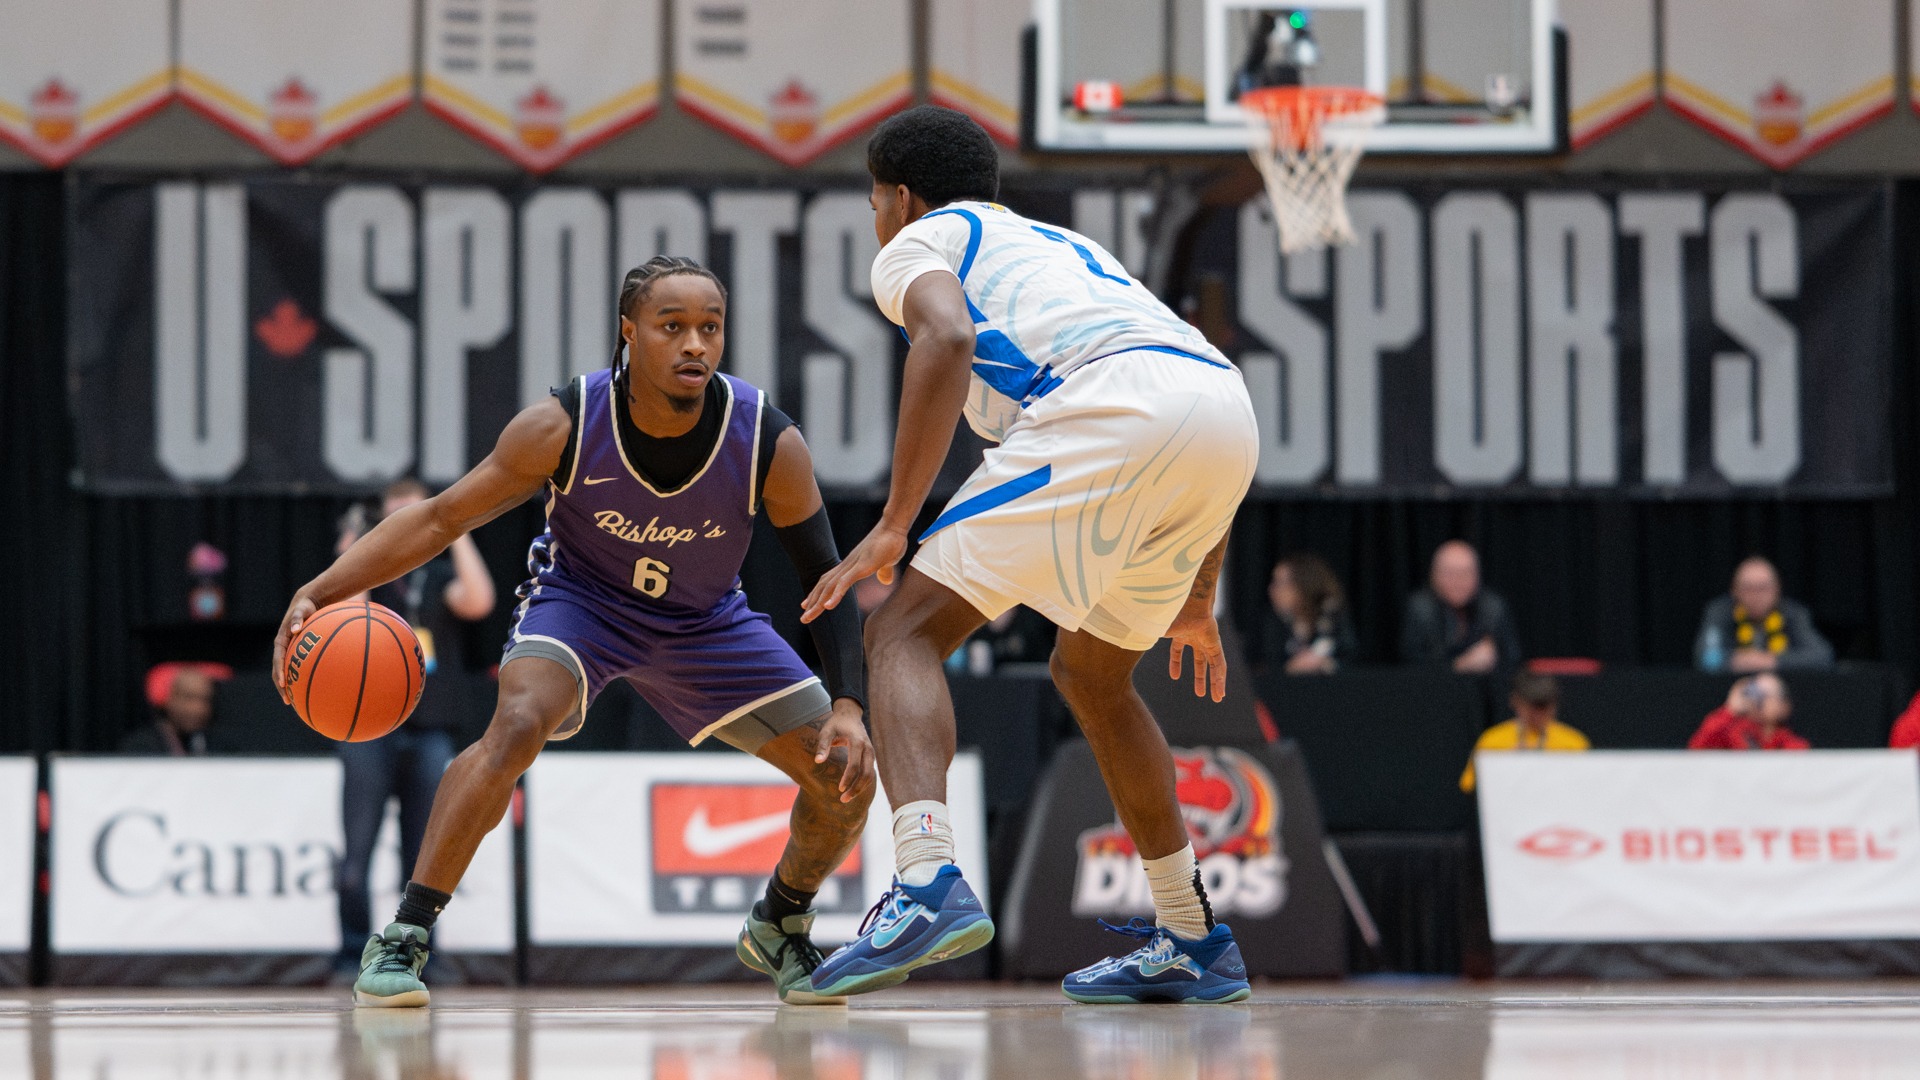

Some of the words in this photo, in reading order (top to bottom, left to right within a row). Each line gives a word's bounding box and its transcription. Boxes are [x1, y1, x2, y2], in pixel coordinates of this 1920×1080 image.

[155, 185, 246, 482] U
[1239, 191, 1798, 487] SPORTS
[594, 510, 726, 548] Bishop's
[631, 556, 674, 600] 6
[94, 810, 466, 898] Cana
[1622, 828, 1897, 862] BIOSTEEL
[668, 876, 842, 908] TE
